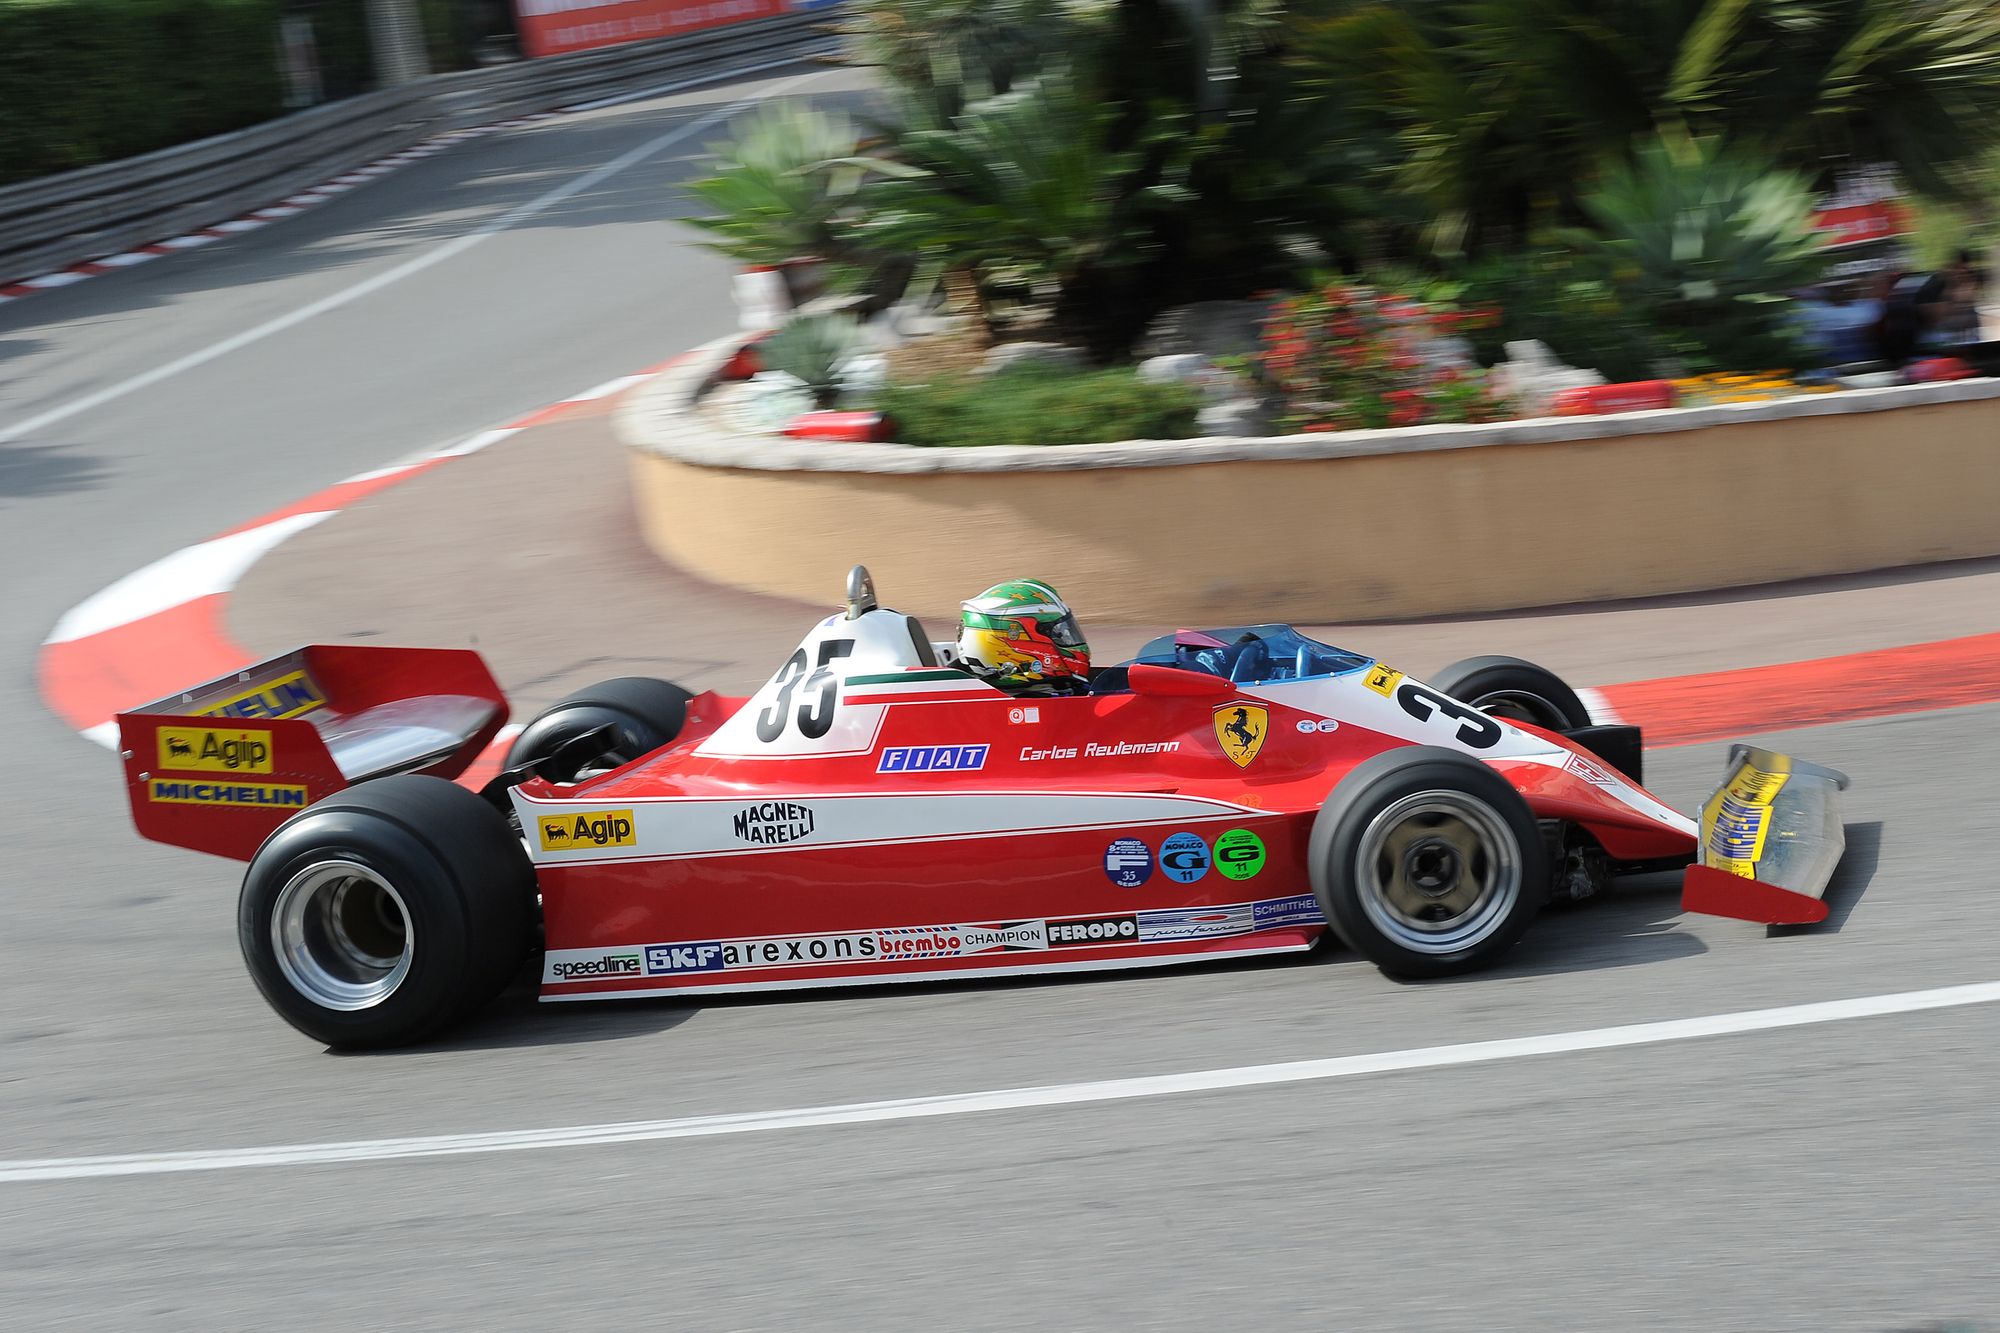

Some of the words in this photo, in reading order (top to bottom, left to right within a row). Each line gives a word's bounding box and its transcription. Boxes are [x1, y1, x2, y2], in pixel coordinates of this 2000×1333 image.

[208, 677, 314, 718] ELIN
[756, 638, 856, 743] 35
[199, 732, 267, 768] Agip
[886, 748, 983, 769] FIAT
[1019, 745, 1078, 762] Carlos
[1084, 741, 1180, 758] Reutemann
[155, 782, 305, 806] MICHELIN
[733, 802, 815, 830] MAGNETI
[573, 814, 631, 844] Agip
[733, 814, 815, 844] MARELLI
[1165, 842, 1204, 850] MONACO
[1219, 845, 1260, 862] G
[1107, 854, 1149, 871] F
[1162, 851, 1209, 870] G
[1234, 862, 1247, 872] 11
[1122, 870, 1136, 881] 35
[1180, 870, 1194, 881] 11
[965, 928, 1041, 946] CHAMPION
[1048, 920, 1135, 942] FERODO
[723, 936, 876, 964] arexons
[879, 934, 961, 953] brembo
[553, 955, 640, 979] speedline
[648, 945, 721, 970] SKF
